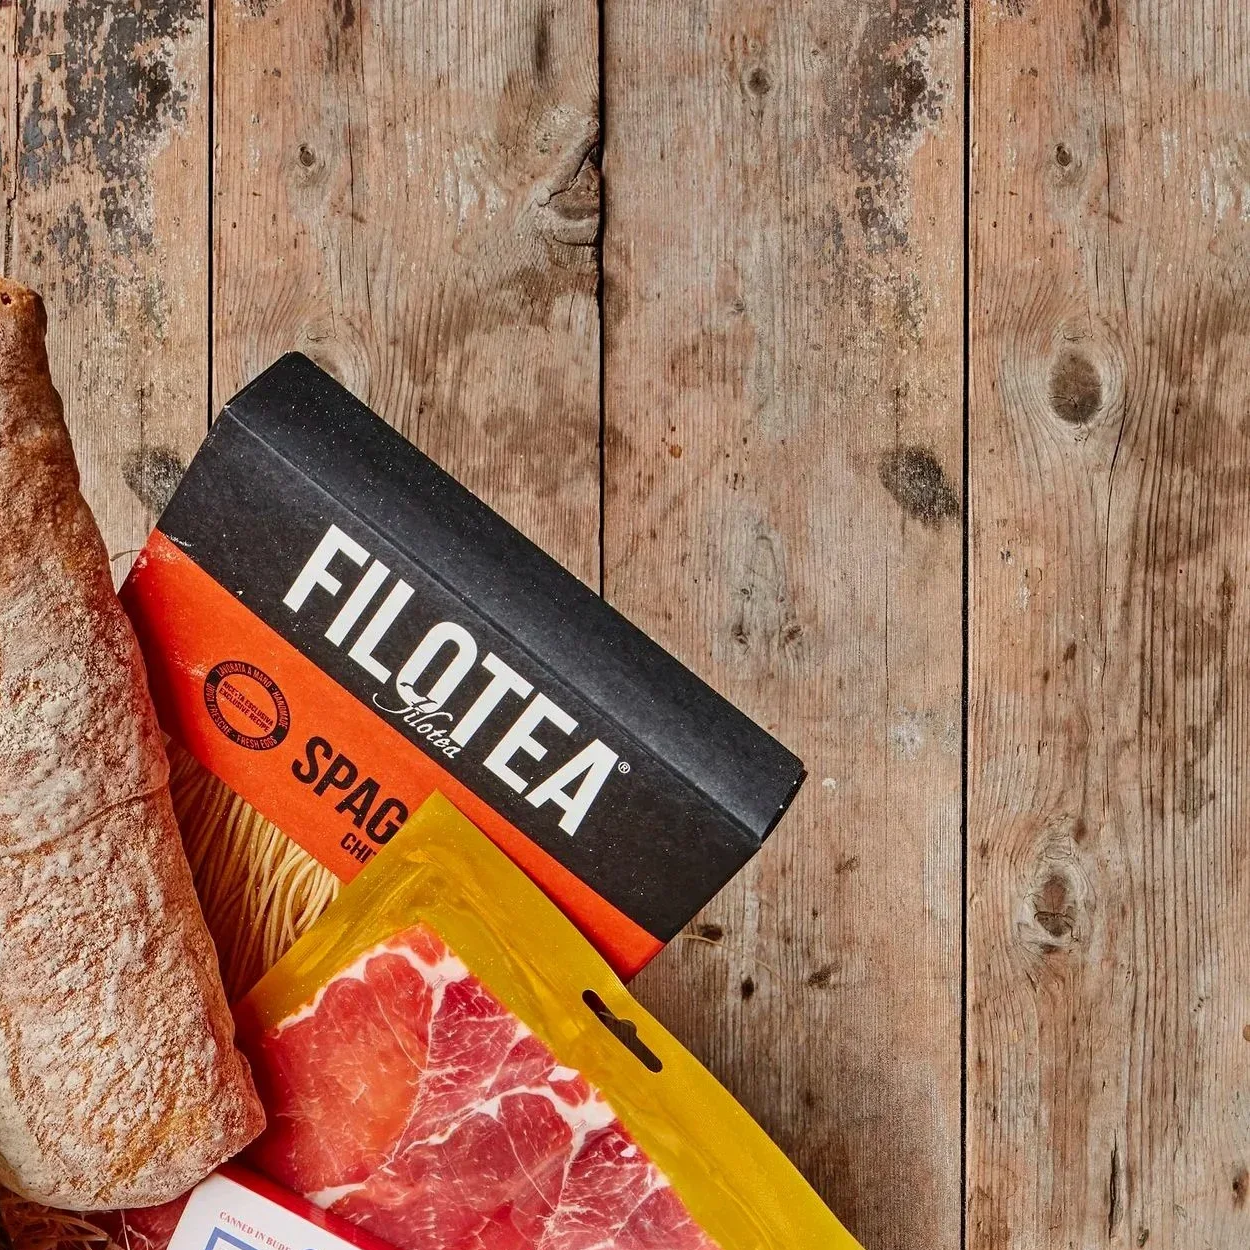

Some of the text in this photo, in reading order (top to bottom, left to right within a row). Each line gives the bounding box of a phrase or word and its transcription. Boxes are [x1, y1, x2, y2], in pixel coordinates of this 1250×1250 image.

[253, 670, 272, 688] MANO
[220, 688, 270, 732] EXCLUSIVE RECIPE
[245, 700, 274, 726] ESCLUSIVA
[237, 735, 260, 749] FRESH
[292, 736, 408, 844] SPAG
[340, 832, 376, 864] CHI
[220, 1212, 254, 1234] CANNED
[255, 1231, 265, 1241] IN
